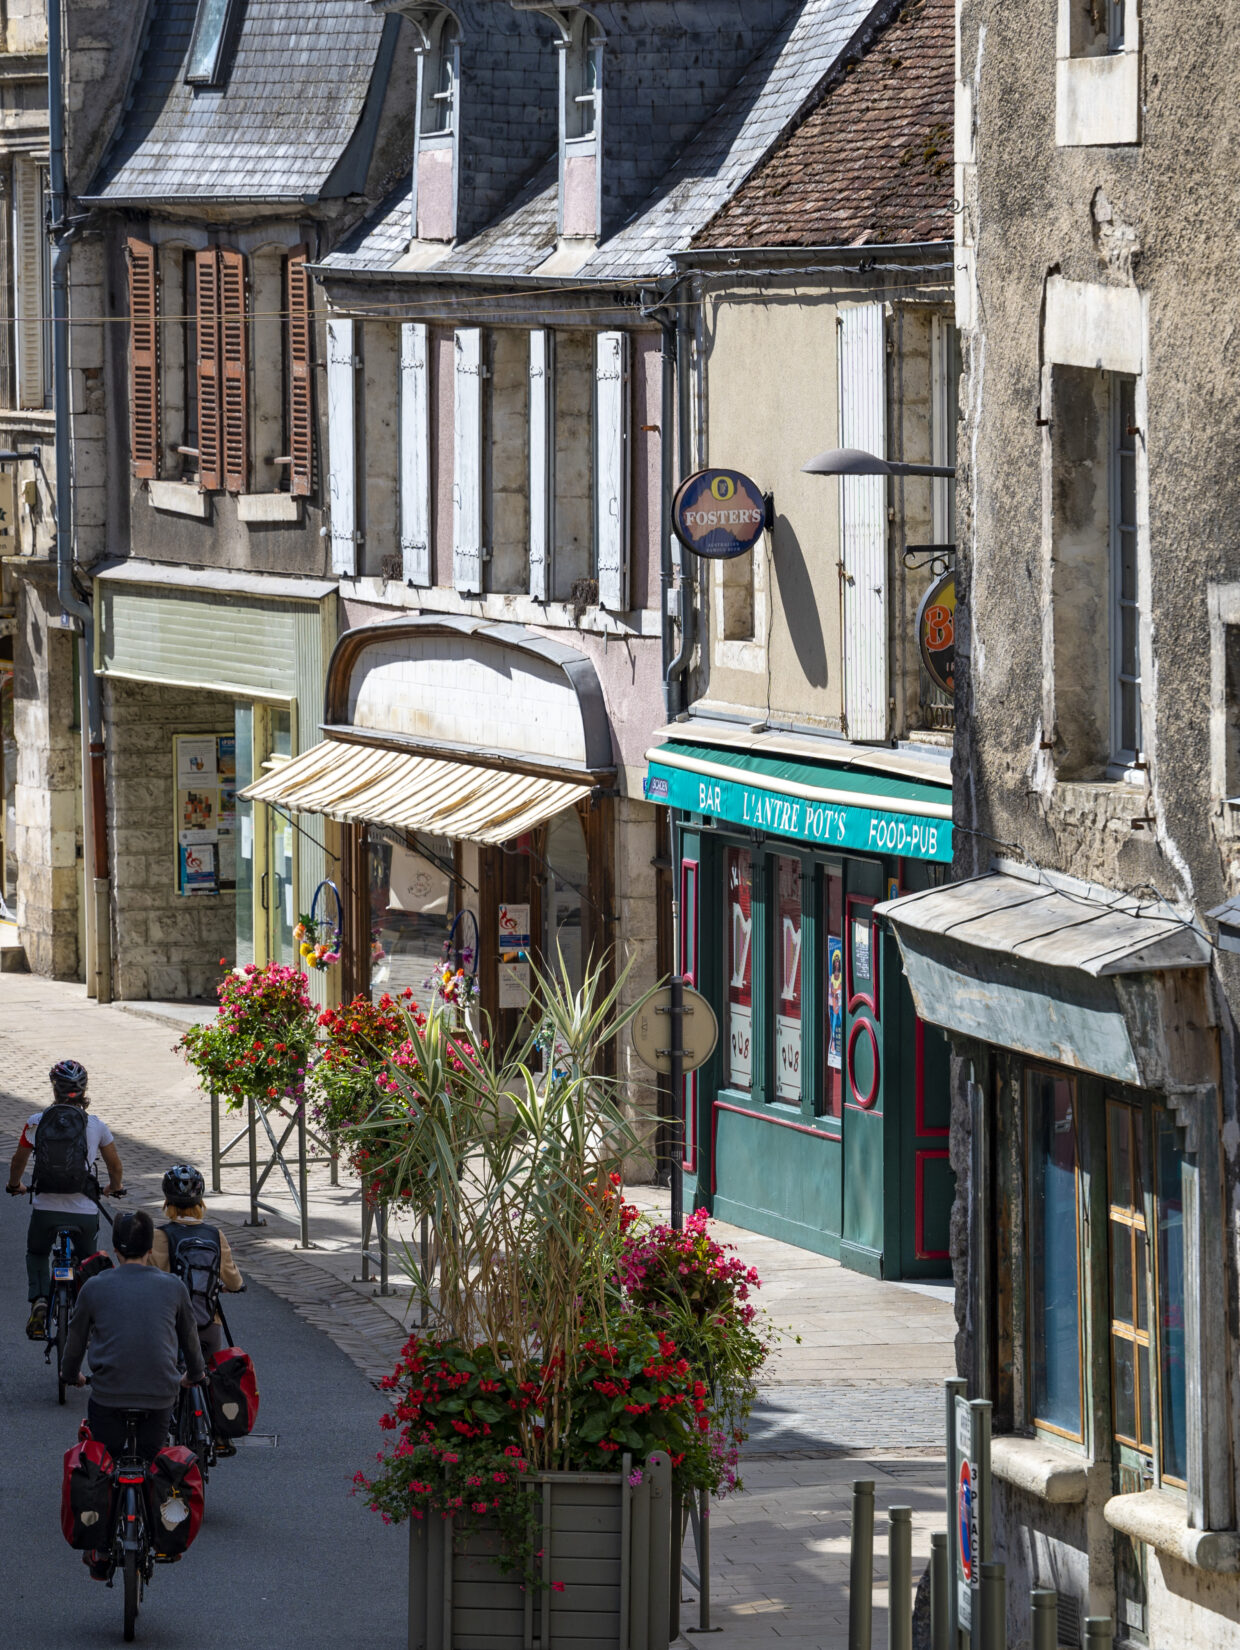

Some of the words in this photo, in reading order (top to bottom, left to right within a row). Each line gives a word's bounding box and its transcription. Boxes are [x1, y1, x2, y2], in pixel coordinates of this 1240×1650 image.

[685, 509, 761, 527] FOSTER'S
[699, 782, 721, 812] BAR
[742, 792, 800, 832] L'ANTRE
[804, 806, 847, 841] POT'S
[868, 818, 938, 855] FOOD-PUB
[971, 1469, 978, 1480] 3
[971, 1490, 979, 1584] PLACES
